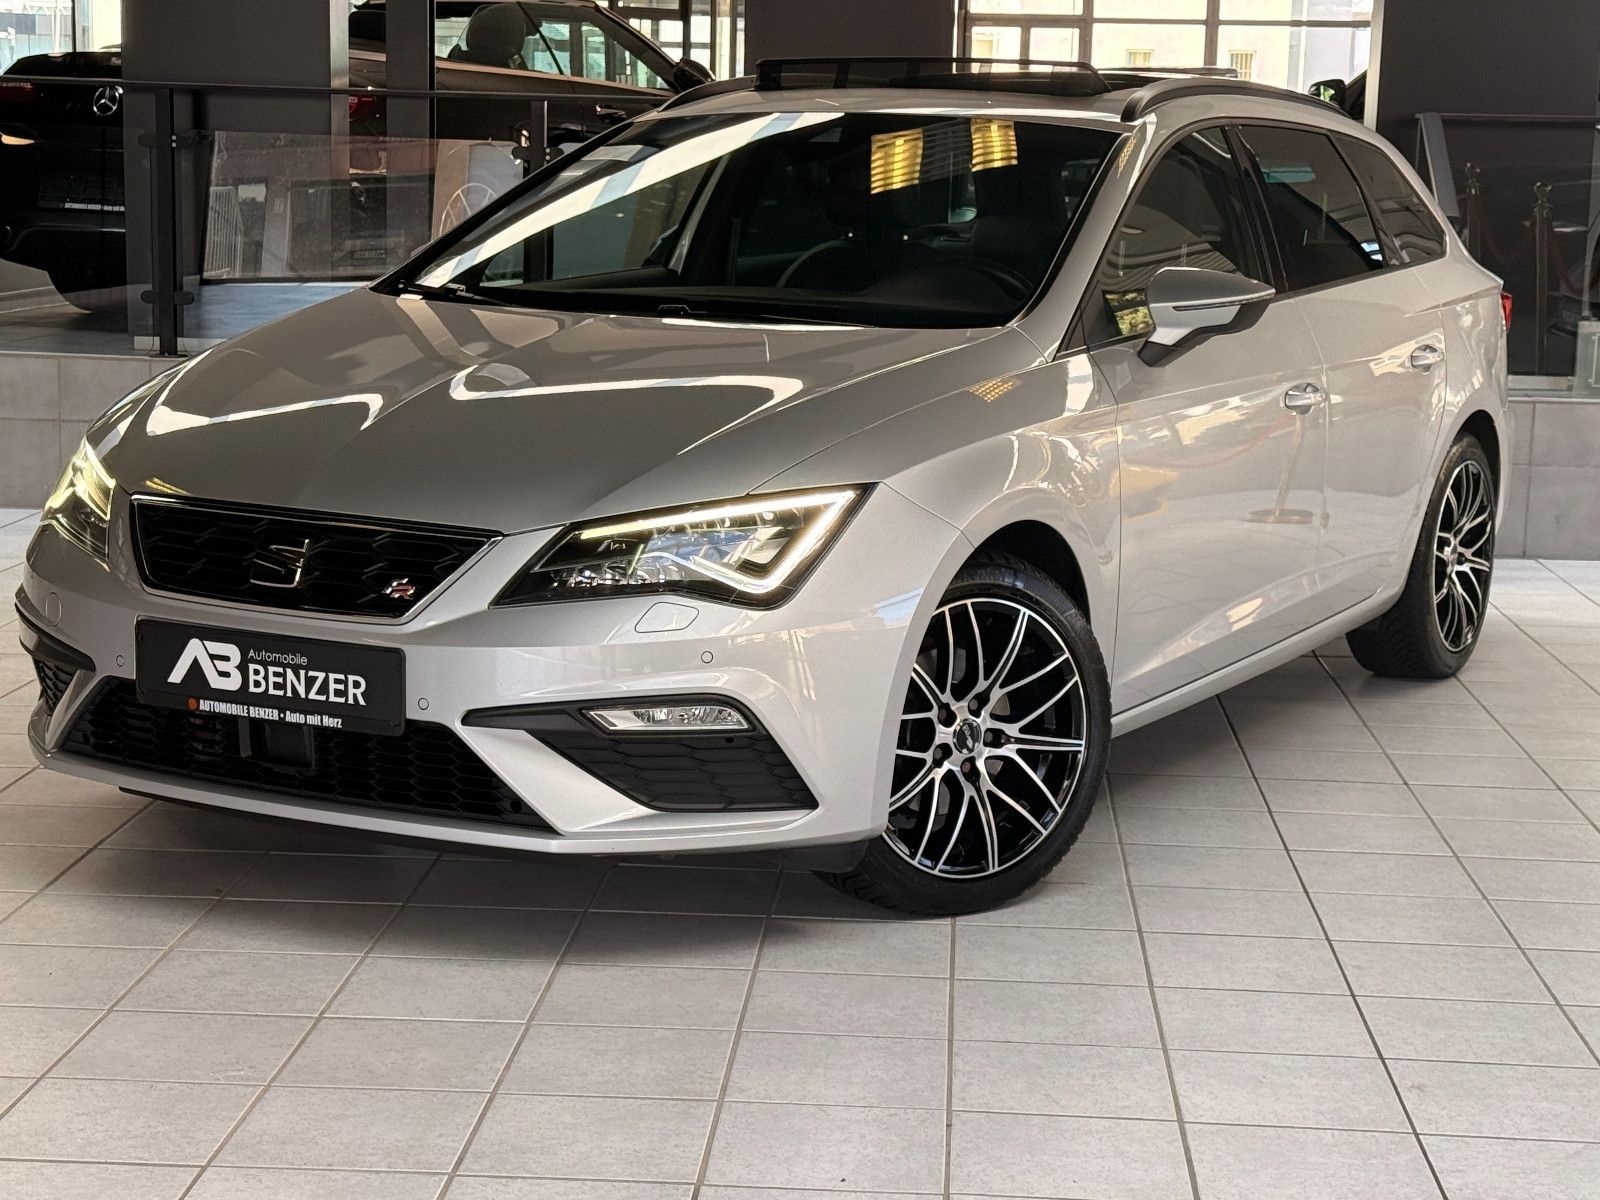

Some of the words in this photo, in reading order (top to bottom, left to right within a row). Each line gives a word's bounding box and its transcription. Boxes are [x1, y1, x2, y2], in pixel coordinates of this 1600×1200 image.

[248, 649, 308, 666] Automobile
[248, 664, 367, 706] BENZER
[199, 700, 248, 717] AUTOMOBILE
[250, 706, 279, 720] BENZER
[285, 711, 305, 724] Auto
[306, 714, 321, 726] mit
[322, 715, 343, 728] Herz
